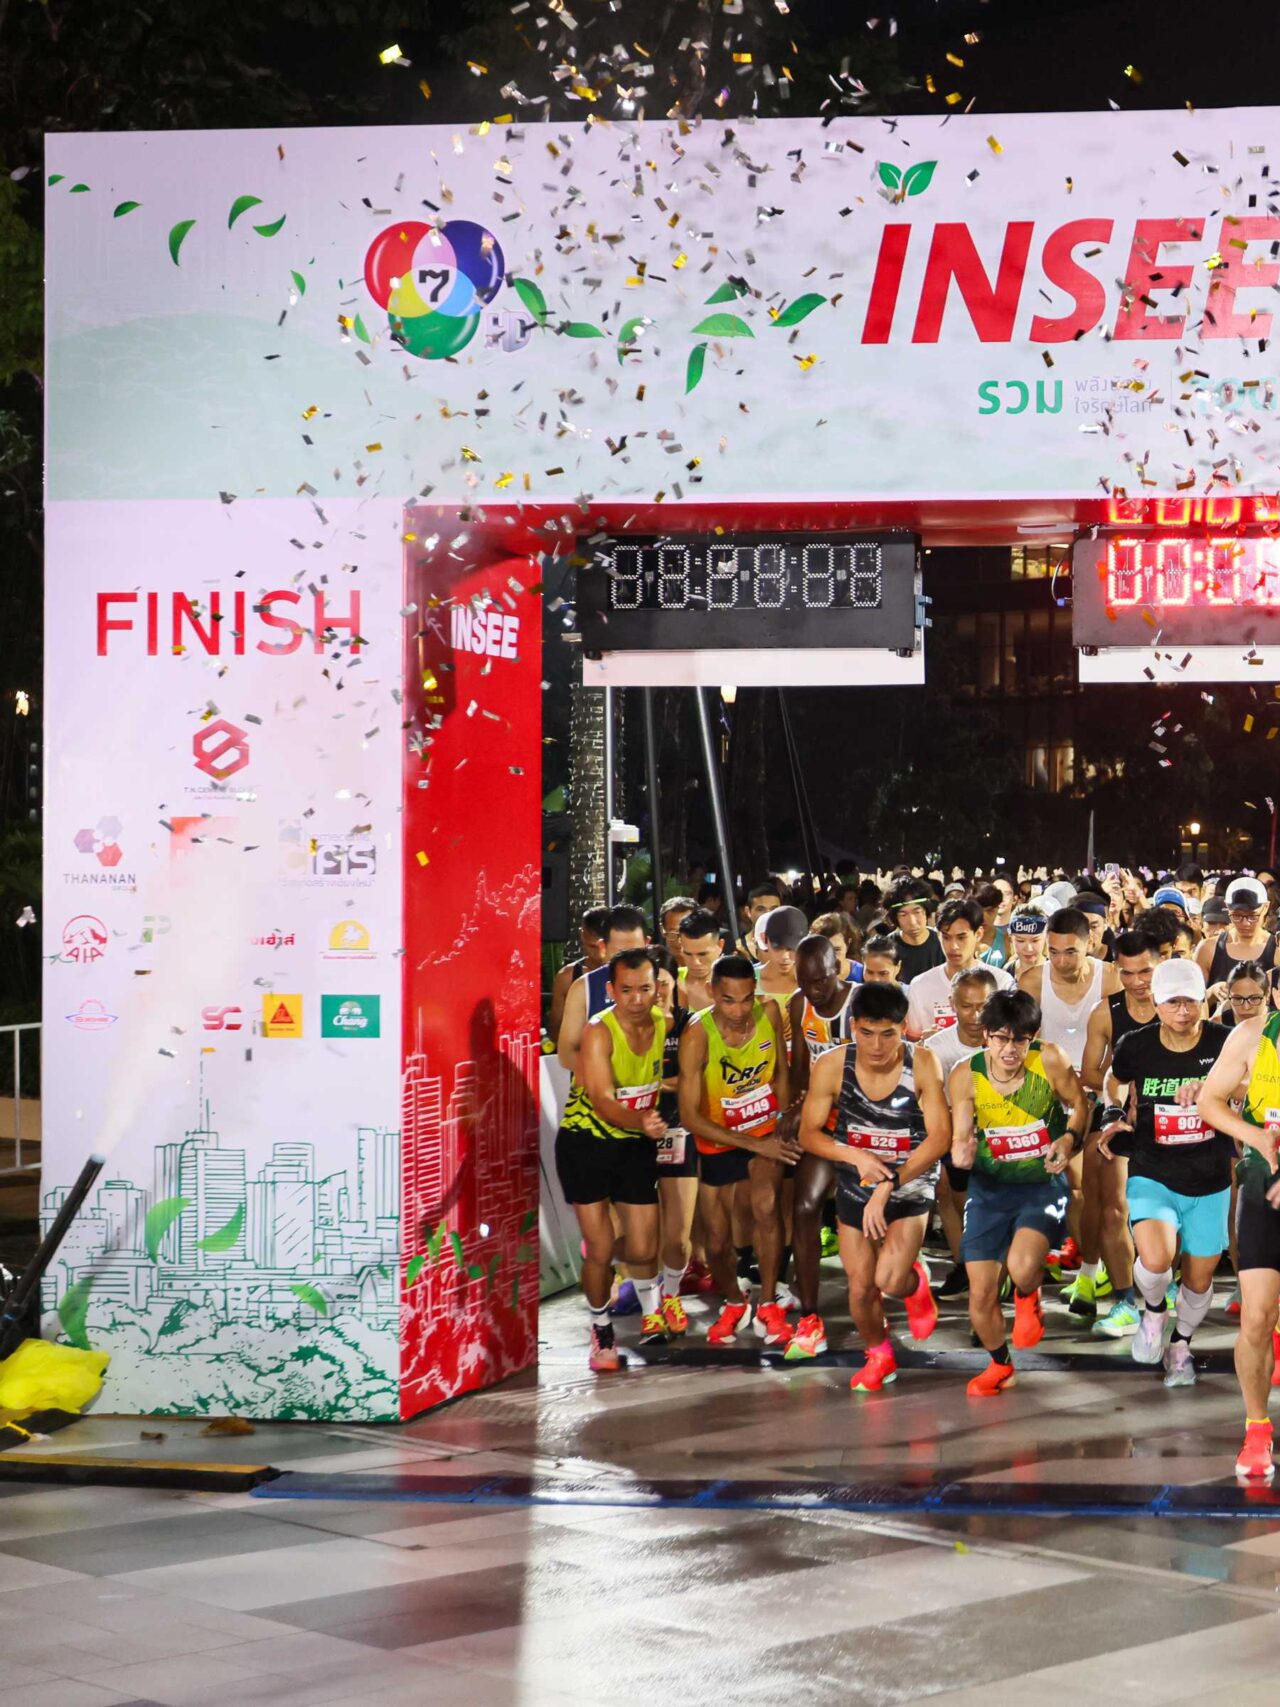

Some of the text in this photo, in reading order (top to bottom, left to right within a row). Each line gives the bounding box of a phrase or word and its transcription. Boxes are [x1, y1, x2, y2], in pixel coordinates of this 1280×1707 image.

[977, 379, 1064, 415] รวม
[95, 589, 361, 656] FINISH
[450, 603, 520, 660] INSEE
[63, 873, 136, 884] THANANAN
[1142, 1075, 1209, 1097] 胜道
[739, 1098, 770, 1119] 1449
[1177, 1116, 1202, 1130] 907
[870, 1135, 898, 1148] 526
[1005, 1132, 1041, 1150] 1360
